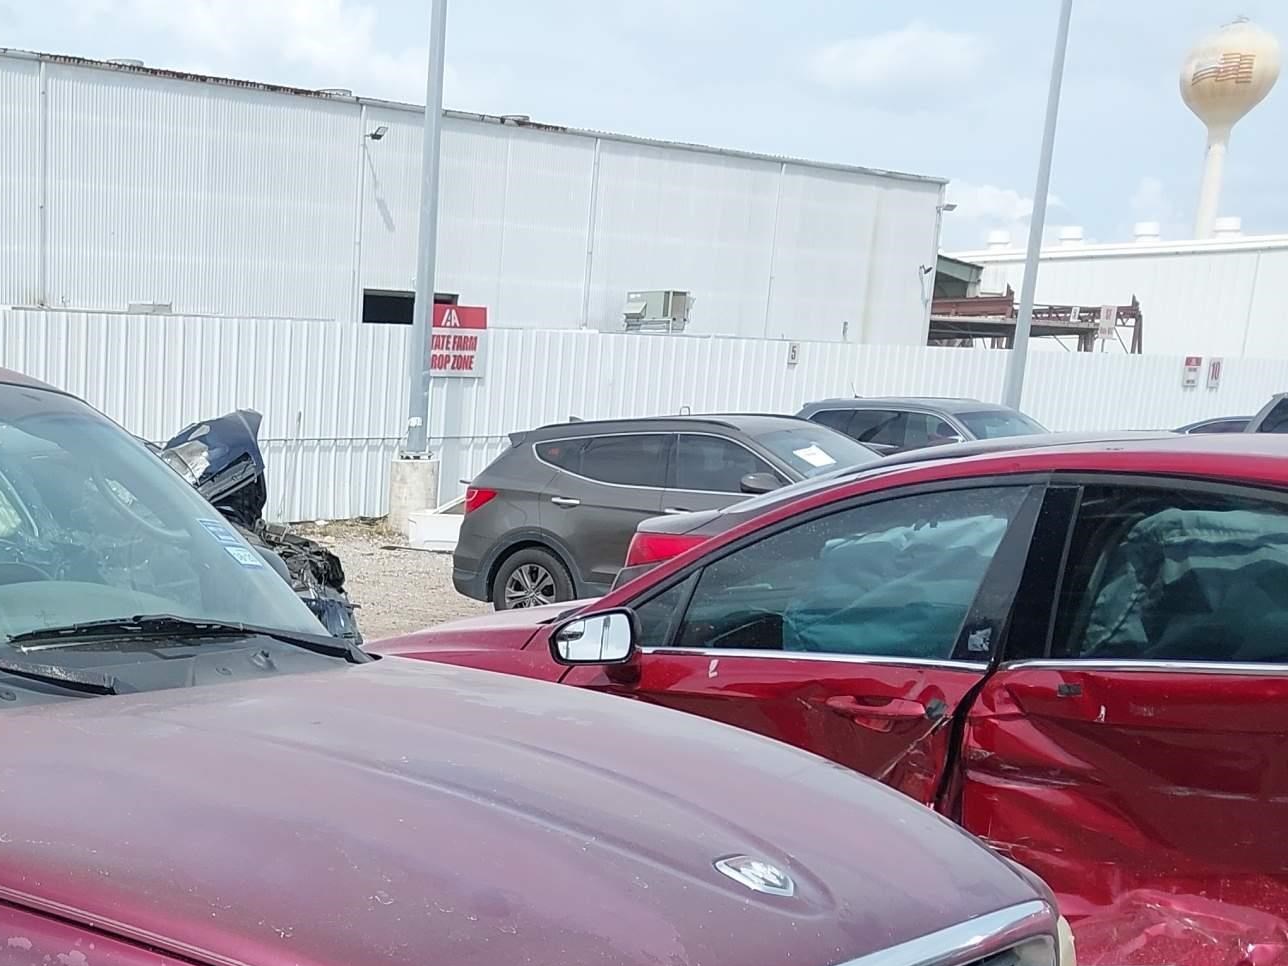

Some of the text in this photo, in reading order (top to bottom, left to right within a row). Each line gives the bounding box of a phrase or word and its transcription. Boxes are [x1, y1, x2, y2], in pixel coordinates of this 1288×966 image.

[431, 334, 478, 351] TATE FARM
[430, 354, 475, 371] ROP ZONE
